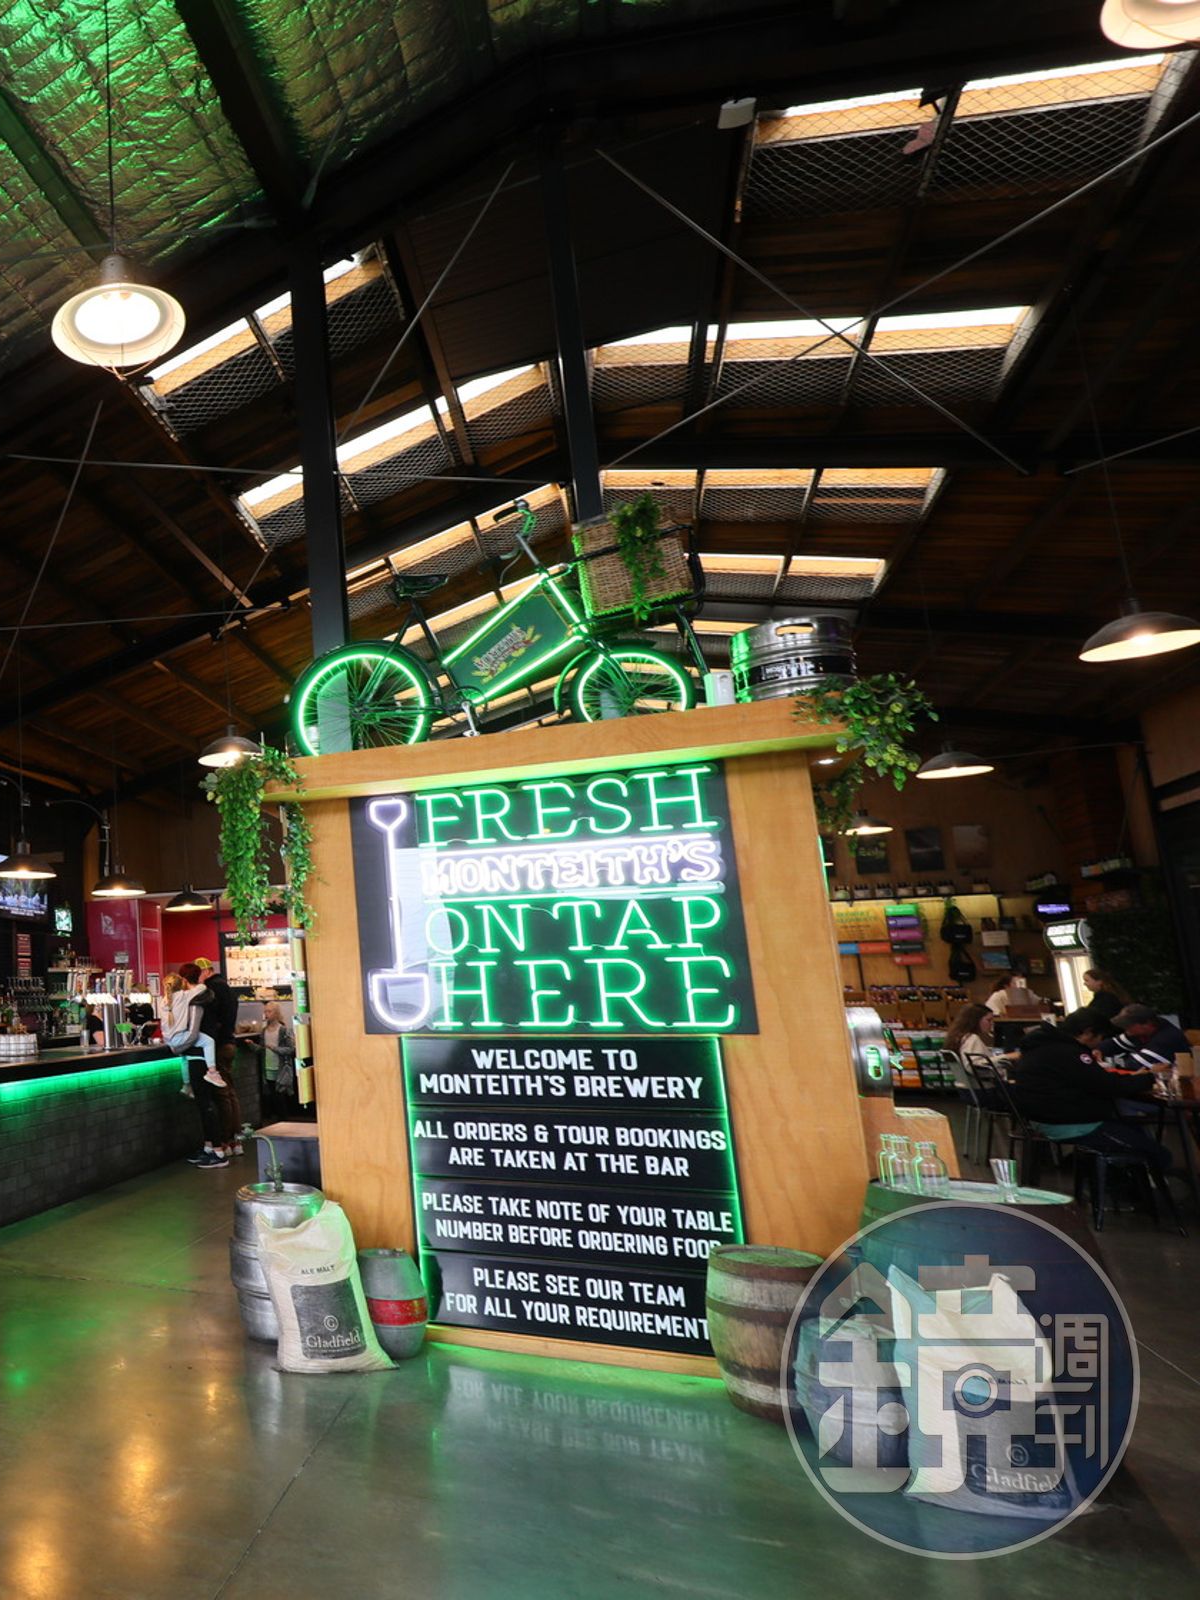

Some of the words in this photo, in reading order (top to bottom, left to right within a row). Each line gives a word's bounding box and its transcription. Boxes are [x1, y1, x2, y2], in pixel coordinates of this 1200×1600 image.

[416, 767, 718, 847] FRESH
[419, 839, 720, 895] MONTEITH'S
[425, 903, 530, 954] ON
[553, 897, 720, 951] TAP
[429, 956, 735, 1027] HERE
[471, 1049, 594, 1070] WELCOME
[602, 1050, 637, 1070] TO
[420, 1074, 566, 1096] MONTEITH'S
[574, 1076, 702, 1098] BREWERY
[414, 1121, 448, 1139] ALL
[454, 1122, 527, 1141] ORDERS
[534, 1125, 548, 1143] &
[554, 1125, 609, 1145] TOUR
[616, 1127, 726, 1151] BOOKINGS
[449, 1147, 485, 1166] ARE
[490, 1149, 556, 1169] TAKEN
[564, 1152, 588, 1171] AT
[596, 1154, 639, 1174] THE
[645, 1156, 689, 1176] BAR
[422, 1193, 484, 1214] PLEASE
[488, 1197, 531, 1217] TAKE
[536, 1200, 583, 1221] NOTE
[588, 1204, 610, 1223] OF
[617, 1205, 667, 1227] YOUR
[672, 1209, 734, 1232] TABLE
[435, 1219, 503, 1242] NUMBER
[508, 1224, 573, 1247] BEFORE
[578, 1230, 668, 1255] ORDERING
[473, 1268, 540, 1292] PLEASE
[545, 1274, 580, 1296] SEE
[586, 1278, 623, 1301] OUR
[629, 1282, 685, 1307] TEAM
[445, 1293, 478, 1314] FOR
[484, 1297, 516, 1318] ALL
[522, 1300, 570, 1324] YOUR
[306, 1328, 361, 1349] Gladfield
